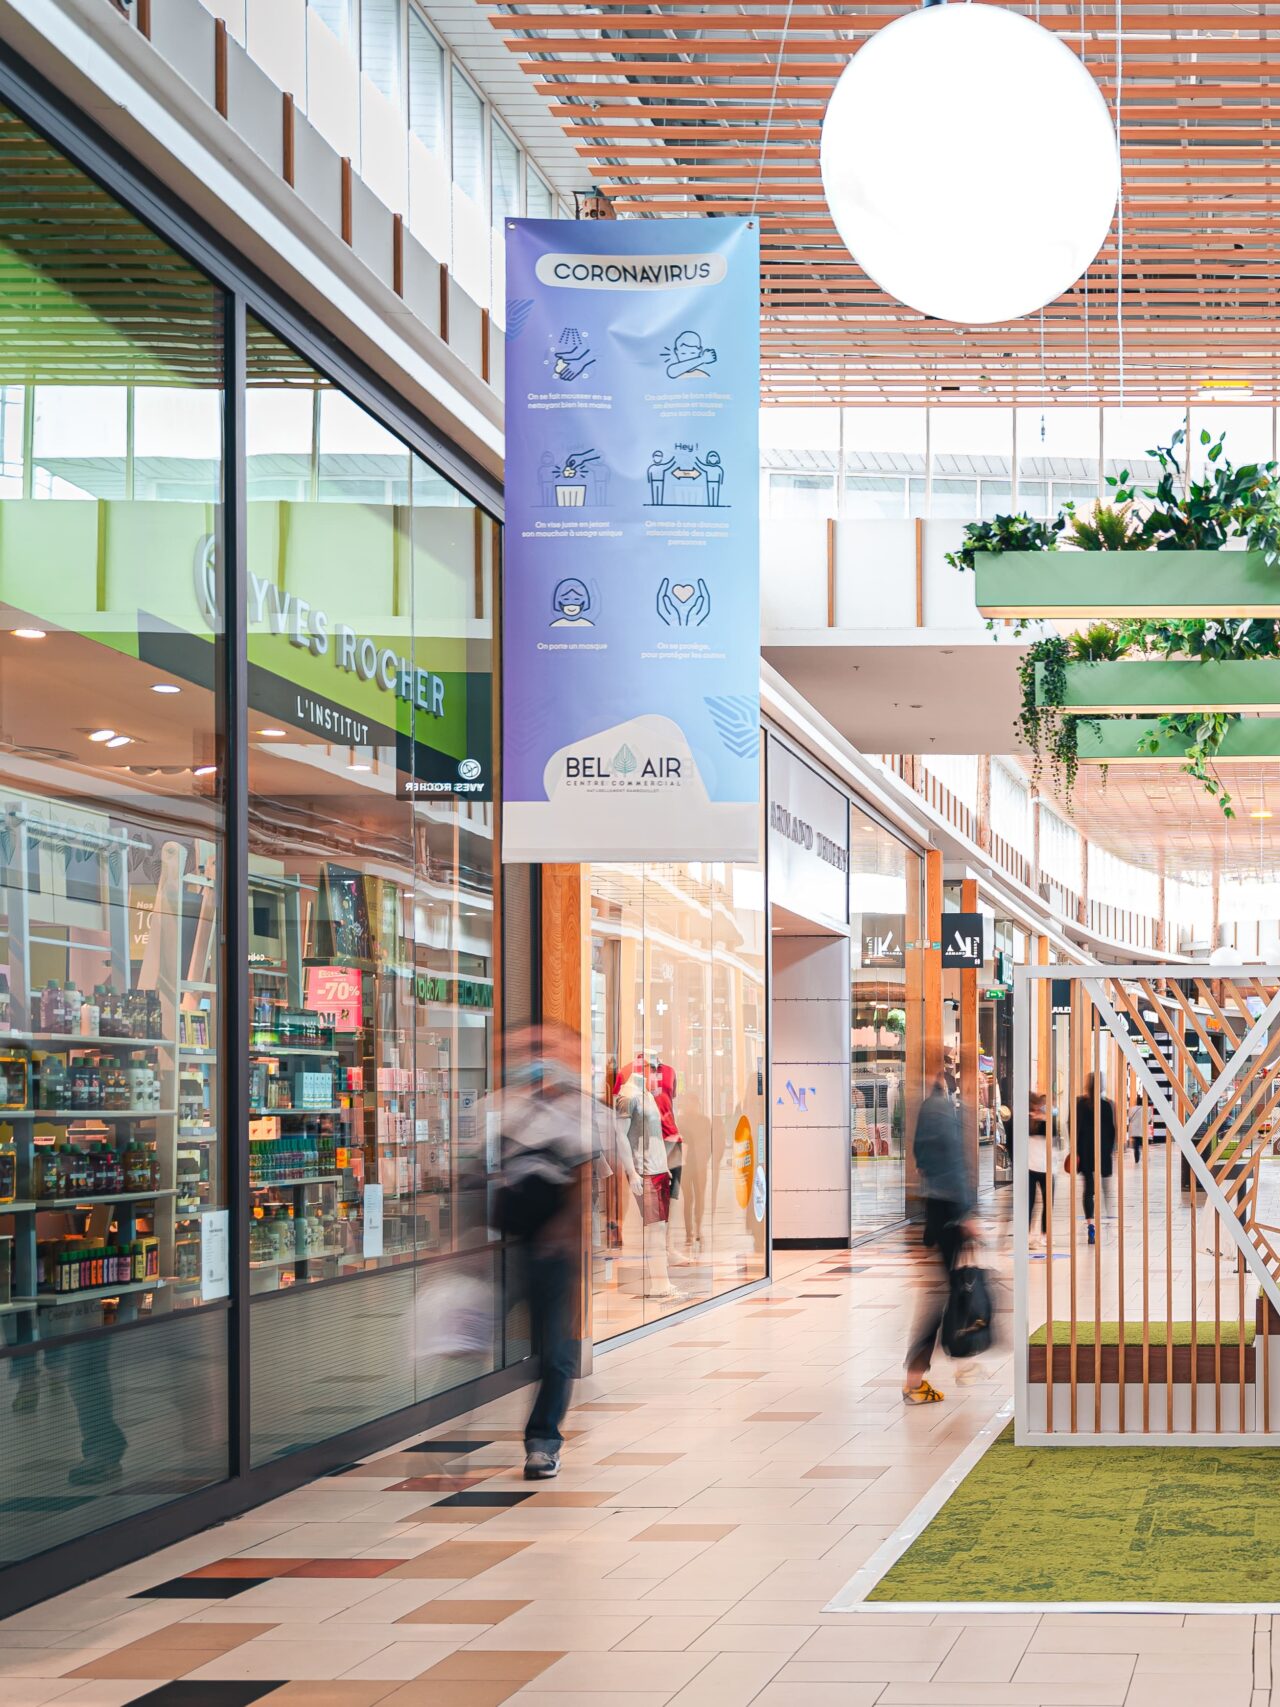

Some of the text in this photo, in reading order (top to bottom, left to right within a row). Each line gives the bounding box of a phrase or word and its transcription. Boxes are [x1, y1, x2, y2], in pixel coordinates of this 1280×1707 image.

[554, 262, 712, 284] CORONAVIRUS
[674, 442, 694, 453] Hey
[247, 570, 446, 718] YVES ROCHER
[297, 695, 369, 745] L'INSTITUT
[566, 757, 682, 778] BEL AIR
[317, 982, 360, 1001] -70%
